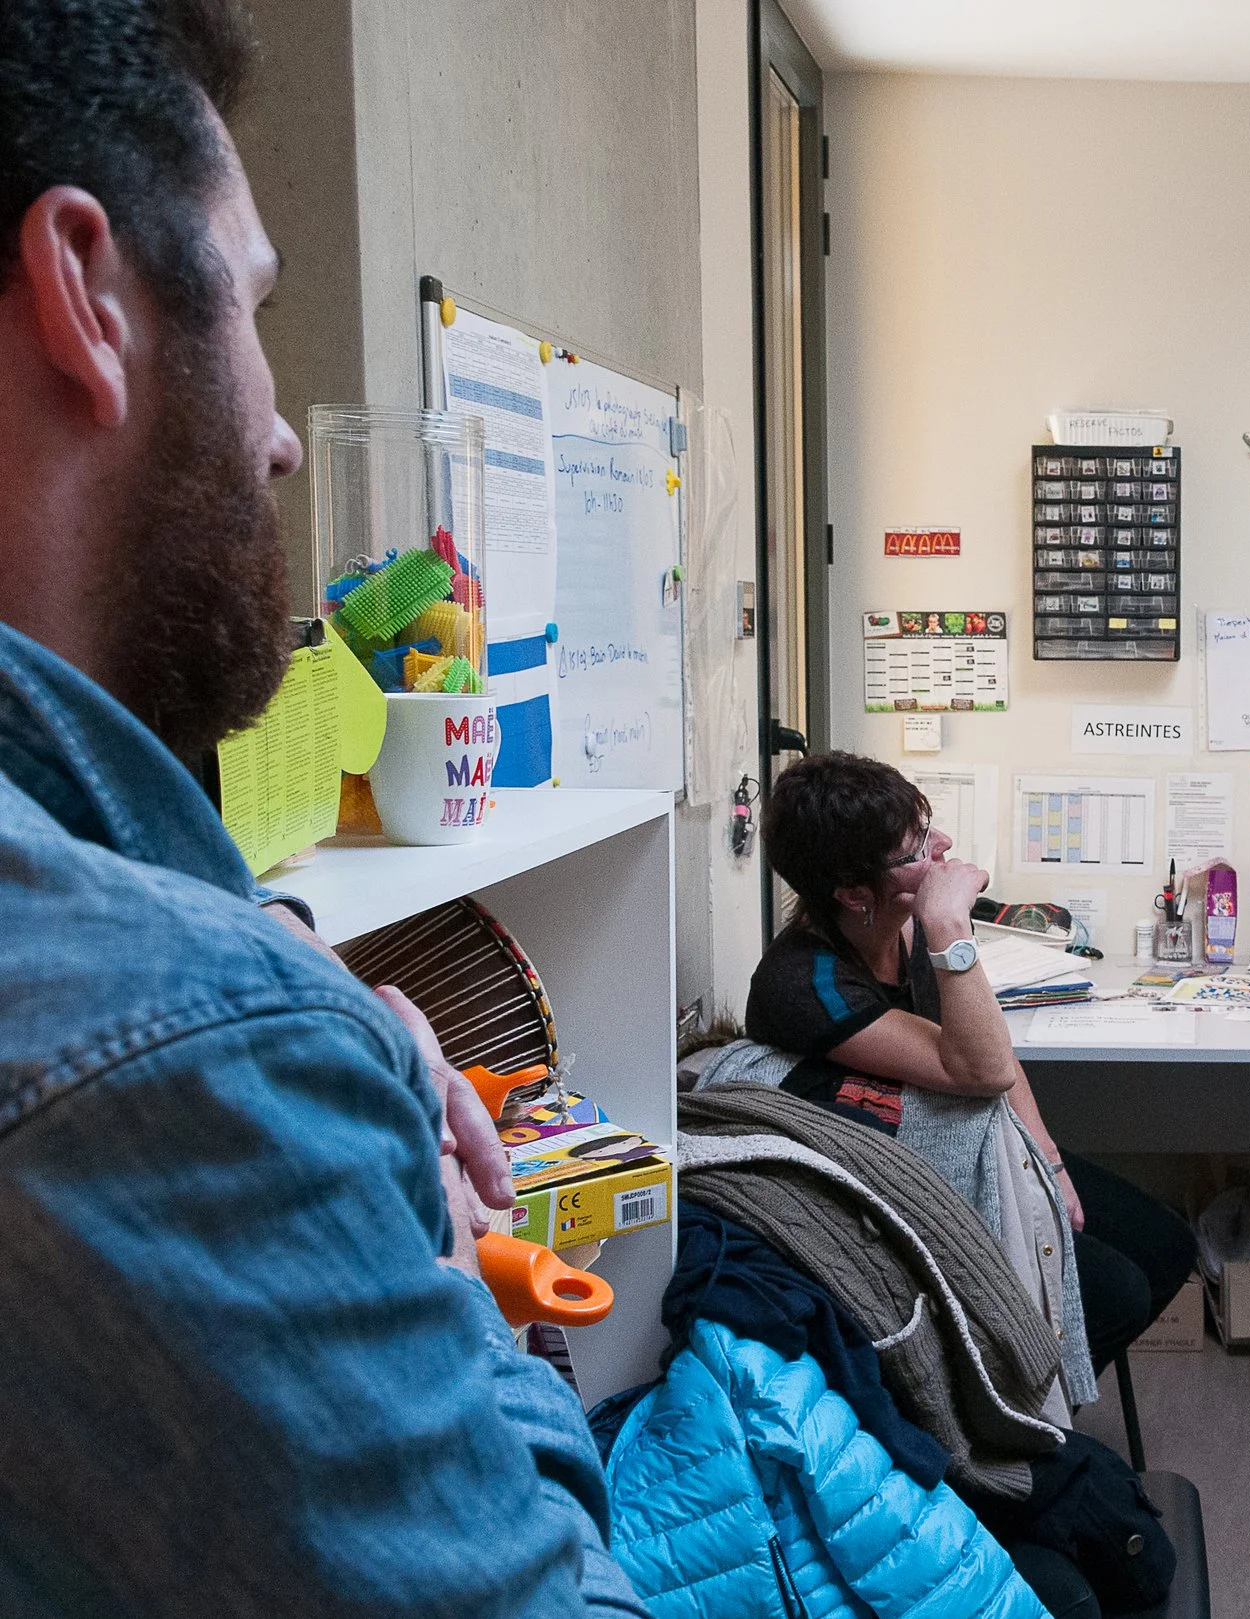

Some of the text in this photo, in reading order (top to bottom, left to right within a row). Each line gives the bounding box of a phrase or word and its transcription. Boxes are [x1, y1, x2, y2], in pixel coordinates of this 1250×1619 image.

[558, 454, 606, 487] Supervision
[1083, 722, 1181, 739] ASTREINTES
[559, 1192, 581, 1211] CE
